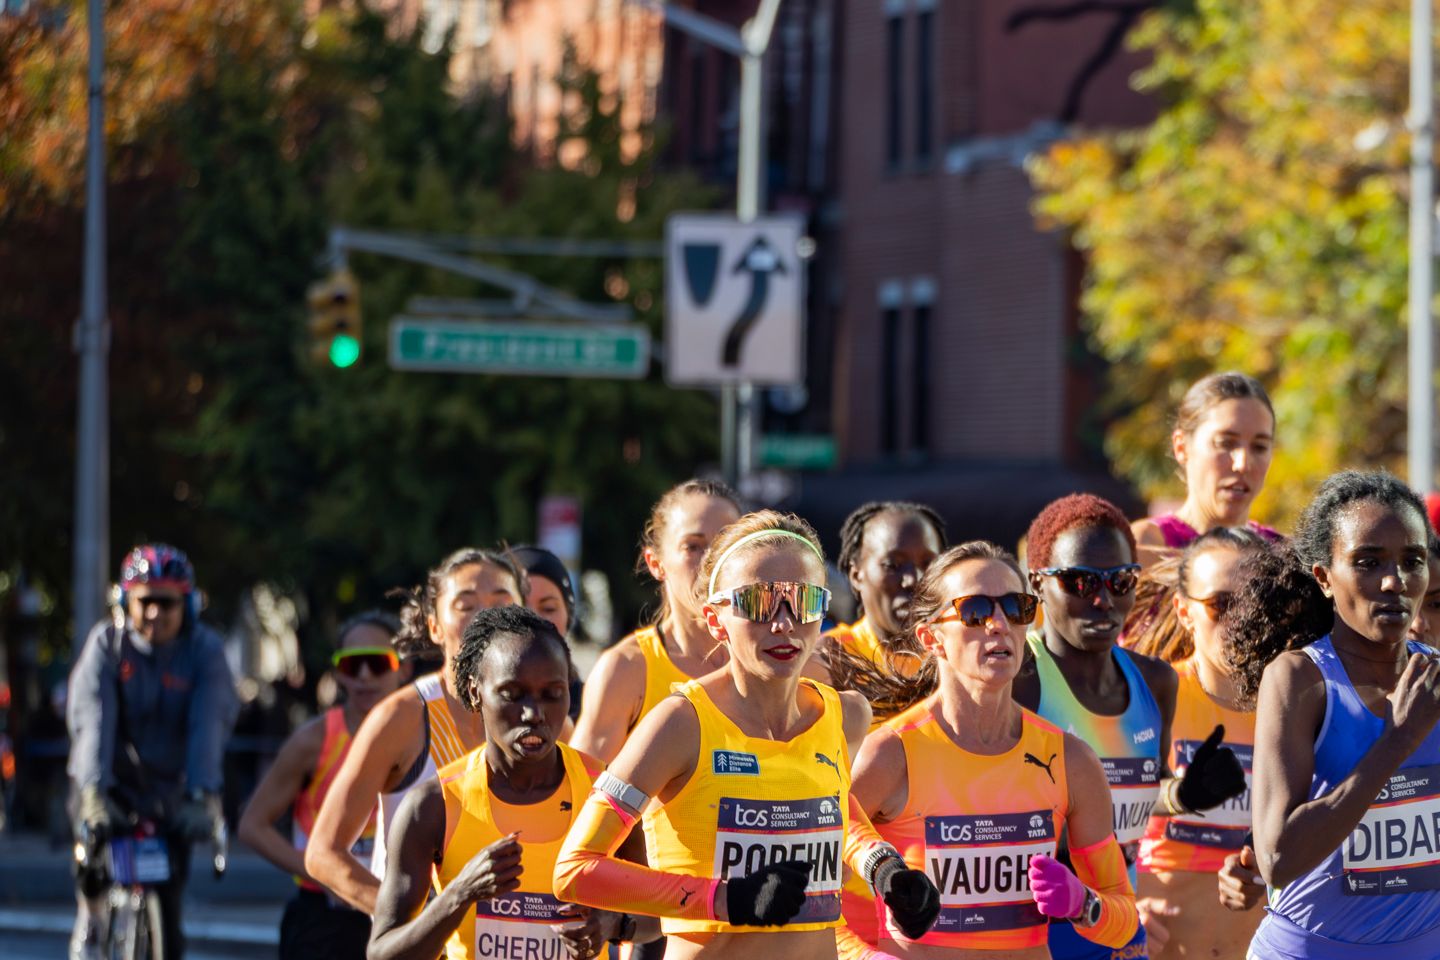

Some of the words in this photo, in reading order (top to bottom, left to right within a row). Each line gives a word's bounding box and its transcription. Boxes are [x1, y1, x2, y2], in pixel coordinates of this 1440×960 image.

[1390, 775, 1406, 783] TATA
[1391, 778, 1429, 791] CONSULTANCY
[1391, 788, 1416, 798] SERVICES
[735, 804, 768, 827] tcs
[771, 811, 810, 820] CONSULTANCY
[770, 820, 797, 828] SERVICES
[817, 816, 835, 825] TATA
[940, 821, 972, 841] tcs
[975, 825, 1018, 834] CONSULTANCY
[1027, 828, 1047, 839] TATA
[974, 832, 1002, 841] SERVICES
[931, 852, 1051, 896] VAUGH
[491, 898, 521, 915] tcs
[524, 910, 552, 918] SERVICES
